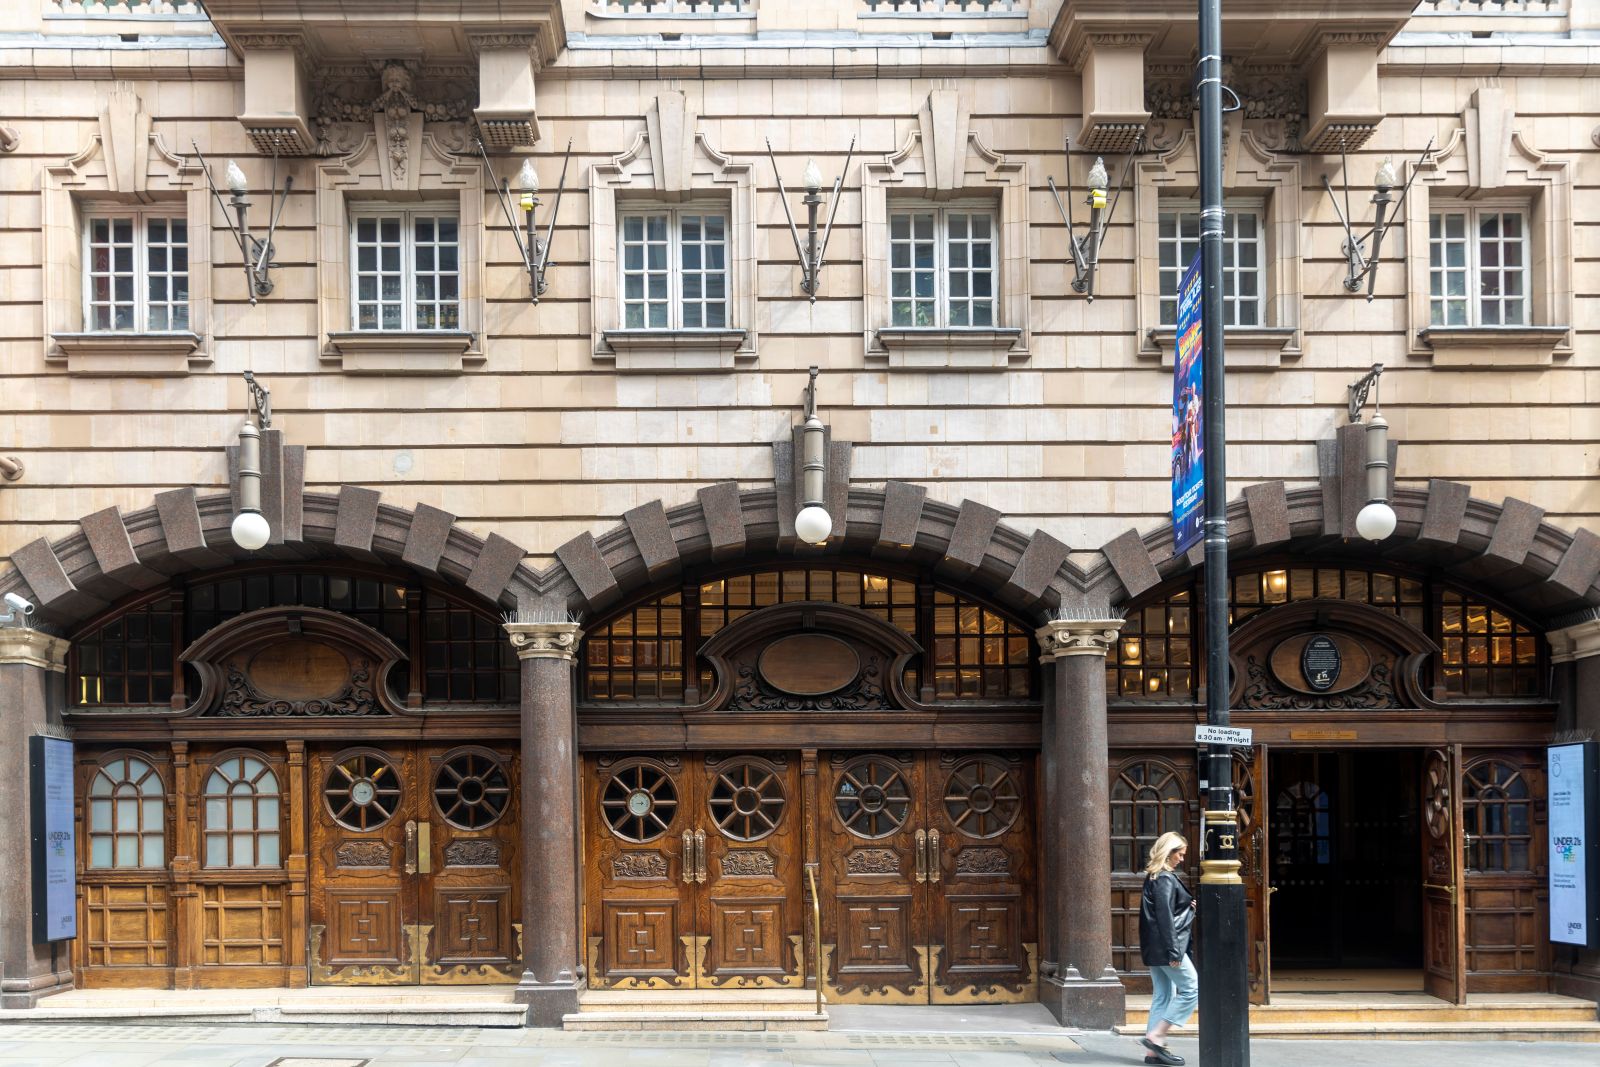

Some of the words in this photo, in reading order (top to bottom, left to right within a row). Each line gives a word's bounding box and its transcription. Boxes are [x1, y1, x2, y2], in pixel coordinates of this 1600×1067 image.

[1218, 728, 1241, 736] loading
[48, 831, 64, 841] UNDER
[1553, 836, 1573, 846] UNDER
[1556, 845, 1573, 854] COME
[1567, 922, 1582, 930] UNDER
